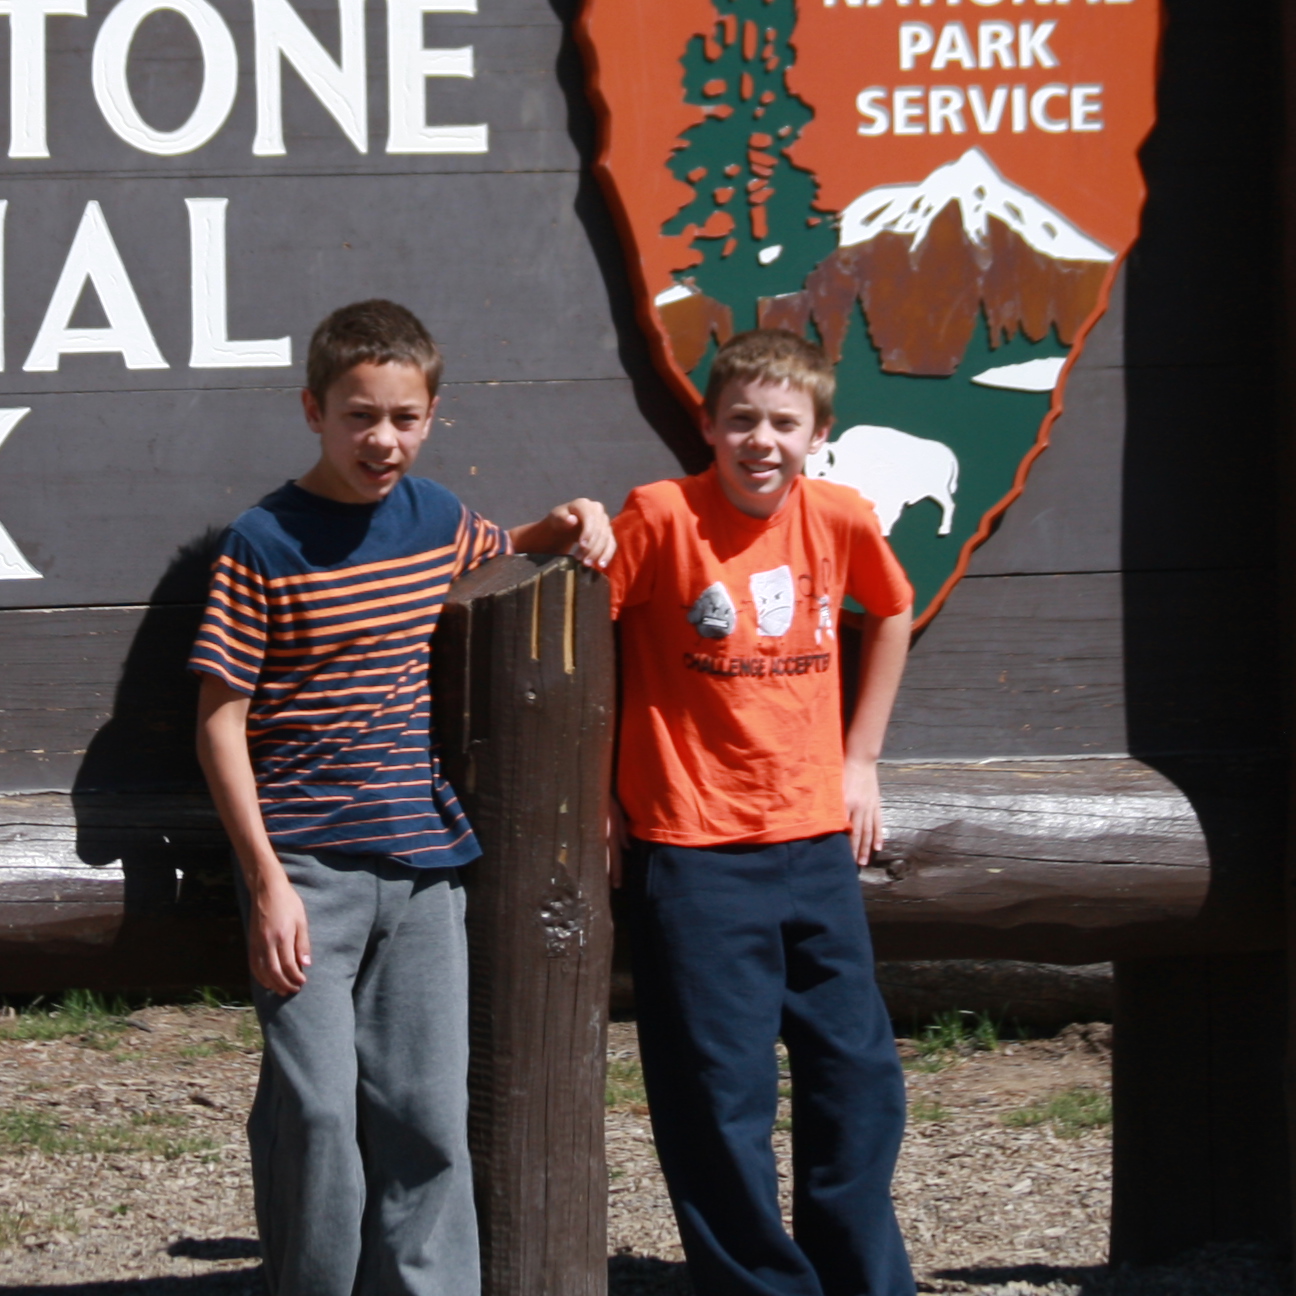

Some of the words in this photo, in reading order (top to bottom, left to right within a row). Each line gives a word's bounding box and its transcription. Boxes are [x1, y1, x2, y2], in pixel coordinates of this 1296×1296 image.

[899, 19, 1060, 71] PARK
[855, 82, 1105, 136] SERVICE
[683, 653, 765, 677] CHALLENGE
